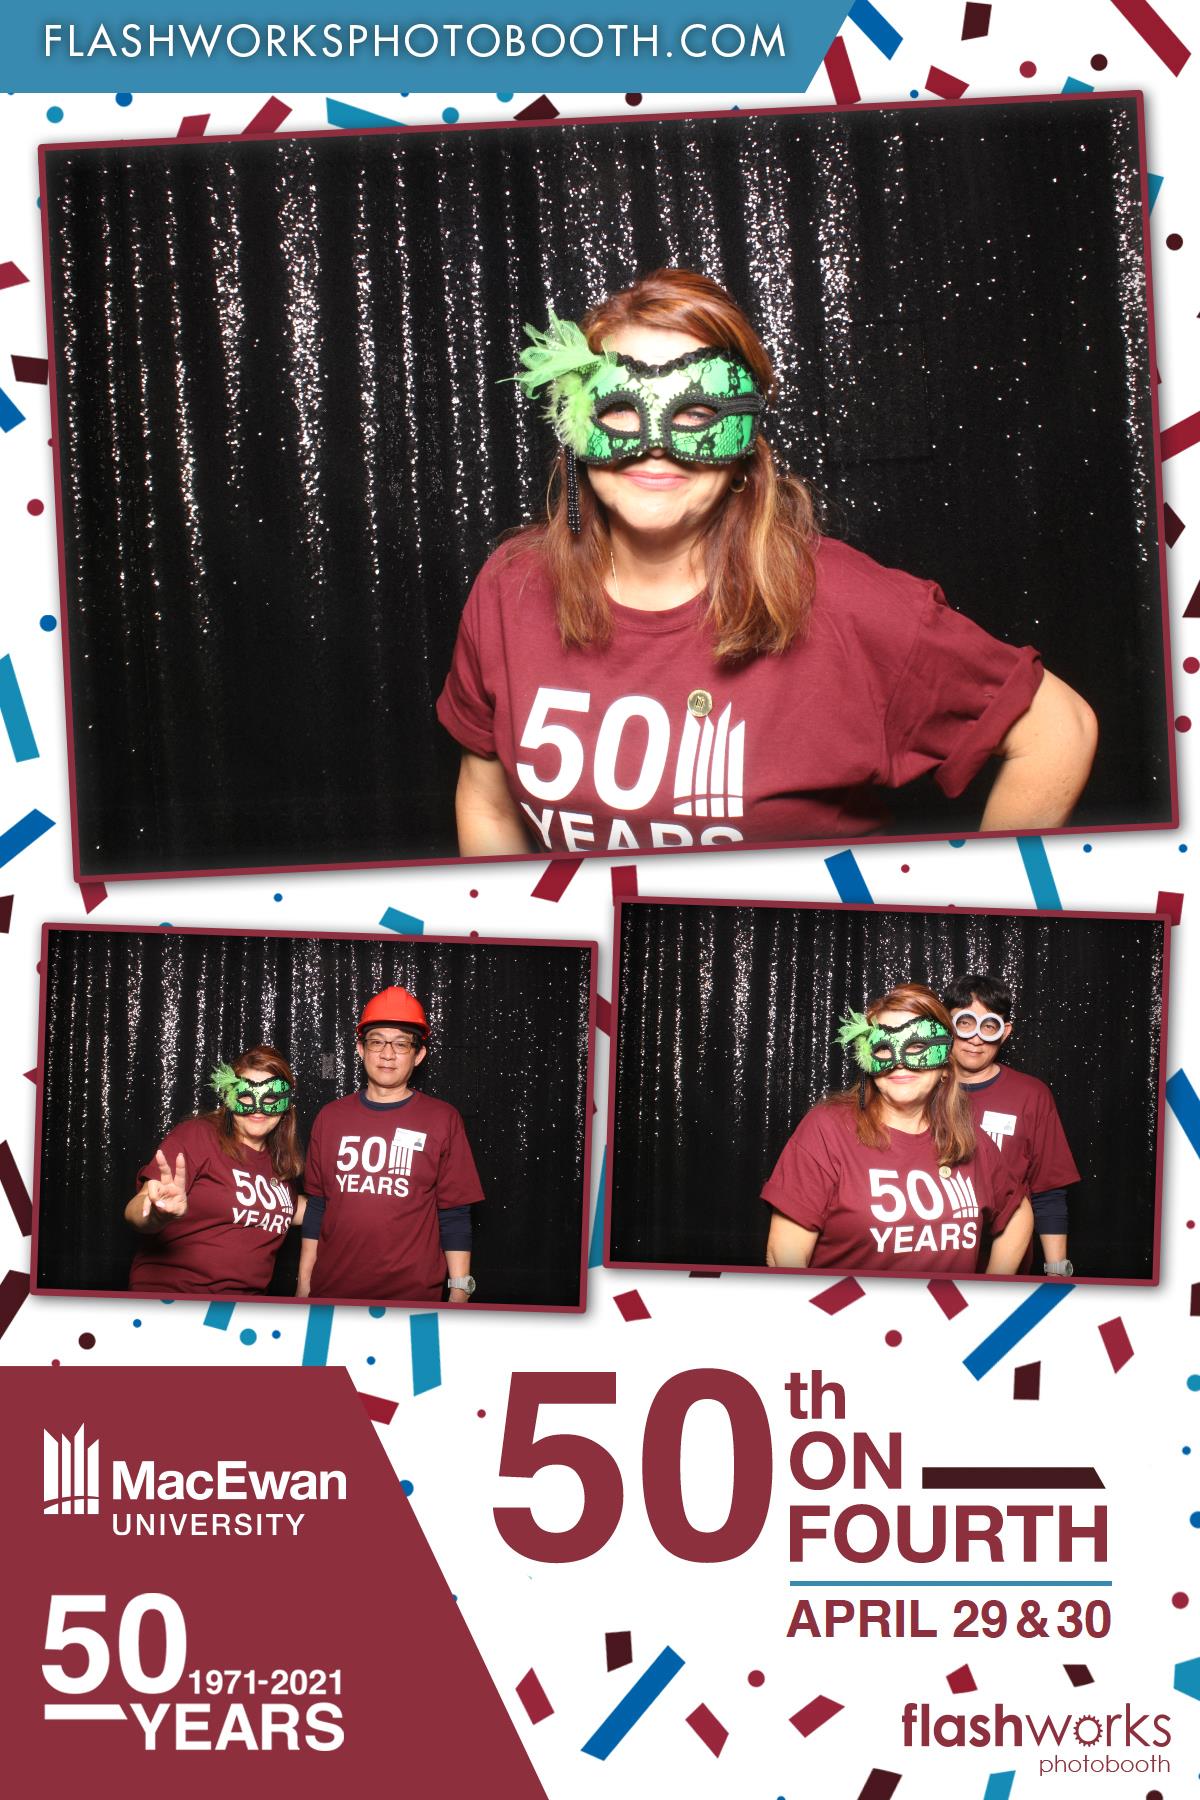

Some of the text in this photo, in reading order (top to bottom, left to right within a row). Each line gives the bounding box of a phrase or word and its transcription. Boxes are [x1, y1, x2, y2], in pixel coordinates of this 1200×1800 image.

[516, 687, 671, 811] 50
[336, 1136, 386, 1173] 50
[232, 1168, 277, 1210] 50
[335, 1174, 409, 1198] YEARS
[868, 1168, 944, 1223] 50
[869, 1221, 977, 1254] YEARS
